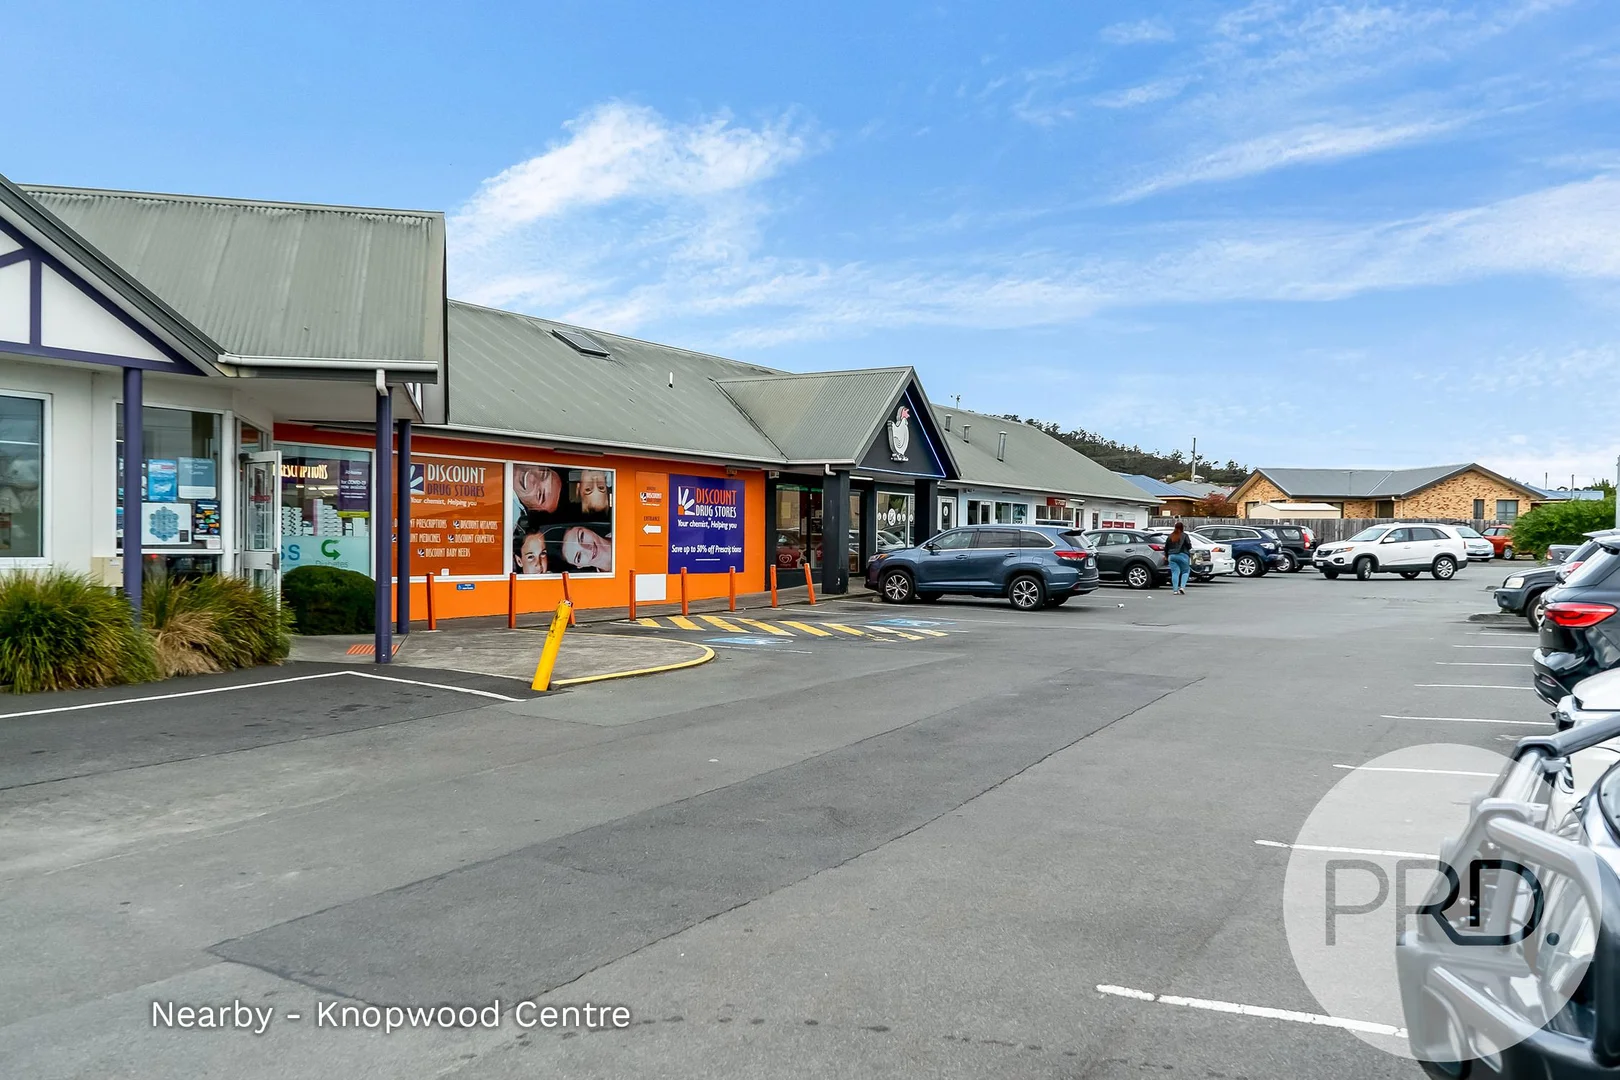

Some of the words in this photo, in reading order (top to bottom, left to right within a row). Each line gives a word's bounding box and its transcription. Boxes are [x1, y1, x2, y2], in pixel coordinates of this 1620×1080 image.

[427, 463, 486, 484] DISCOUNT
[427, 483, 451, 496] DRUG
[454, 484, 485, 497] STORES
[696, 488, 737, 505] DISCOUNT
[447, 499, 467, 507] Helping
[695, 504, 713, 517] DRUG
[714, 505, 737, 518] STORES
[416, 518, 447, 529] PRESCRIPTIONS
[460, 520, 479, 529] DISCOUNT
[677, 519, 689, 527] Your
[710, 521, 728, 530] Helping
[419, 533, 441, 543] MEDICINES
[454, 533, 474, 543] DISCOUNT
[425, 547, 445, 557] DISCOUNT
[446, 548, 457, 557] BABY
[458, 548, 471, 557] NEEDS
[671, 544, 683, 553] Save
[683, 546, 690, 555] up
[696, 544, 707, 553] 50%
[708, 544, 716, 555] off
[715, 545, 742, 555] Prescriptions
